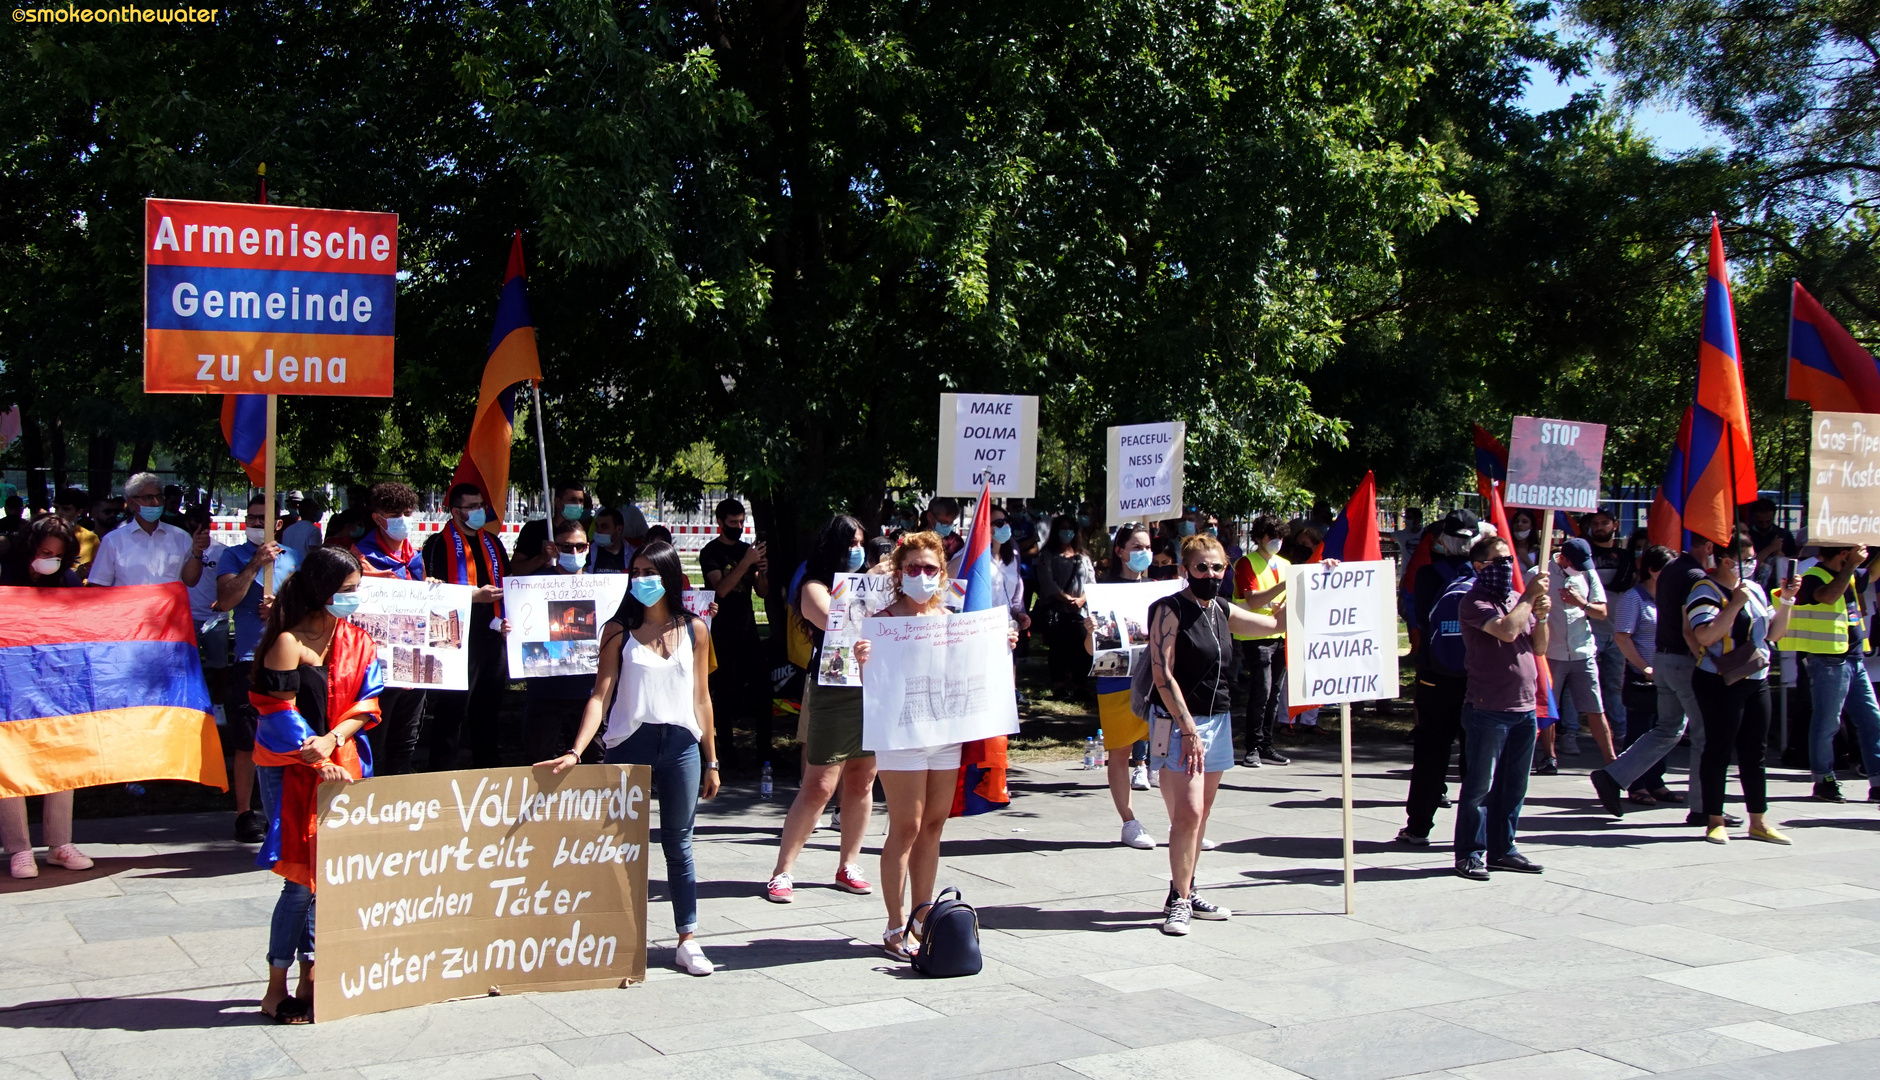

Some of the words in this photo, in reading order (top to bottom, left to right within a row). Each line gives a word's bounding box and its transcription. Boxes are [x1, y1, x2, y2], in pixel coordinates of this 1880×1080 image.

[153, 216, 390, 262] Armenische
[172, 282, 373, 323] Gemeinde
[196, 354, 240, 382] zu
[253, 349, 347, 384] Jena
[970, 402, 1013, 415] MAKE
[963, 426, 1017, 440] DOLMA
[1121, 433, 1172, 447] PEACEFUL-
[1541, 422, 1581, 446] STOP
[974, 449, 1007, 461] NOT
[1128, 454, 1153, 467] NESS
[1154, 453, 1163, 464] IS
[972, 472, 1006, 486] WAR
[1135, 476, 1156, 488] NOT
[1119, 494, 1171, 510] WEAKNESS
[1506, 483, 1598, 509] AGGRESSION
[1816, 495, 1880, 537] Armenie
[510, 578, 566, 590] Armenische
[1310, 569, 1375, 591] STOPPT
[381, 602, 427, 614] Völkermord
[1328, 607, 1357, 626] DIE
[875, 621, 898, 637] Das
[1307, 638, 1379, 660] KAVIAR-
[1311, 674, 1379, 697] POLITIK
[326, 792, 441, 831] Solange
[451, 770, 643, 832] Völkermorde
[325, 836, 535, 885] unverurteilt
[553, 834, 641, 868] bleiben
[357, 885, 473, 931] versuchen
[489, 876, 592, 918] Täter
[340, 946, 437, 999] weiter
[484, 920, 618, 972] morden
